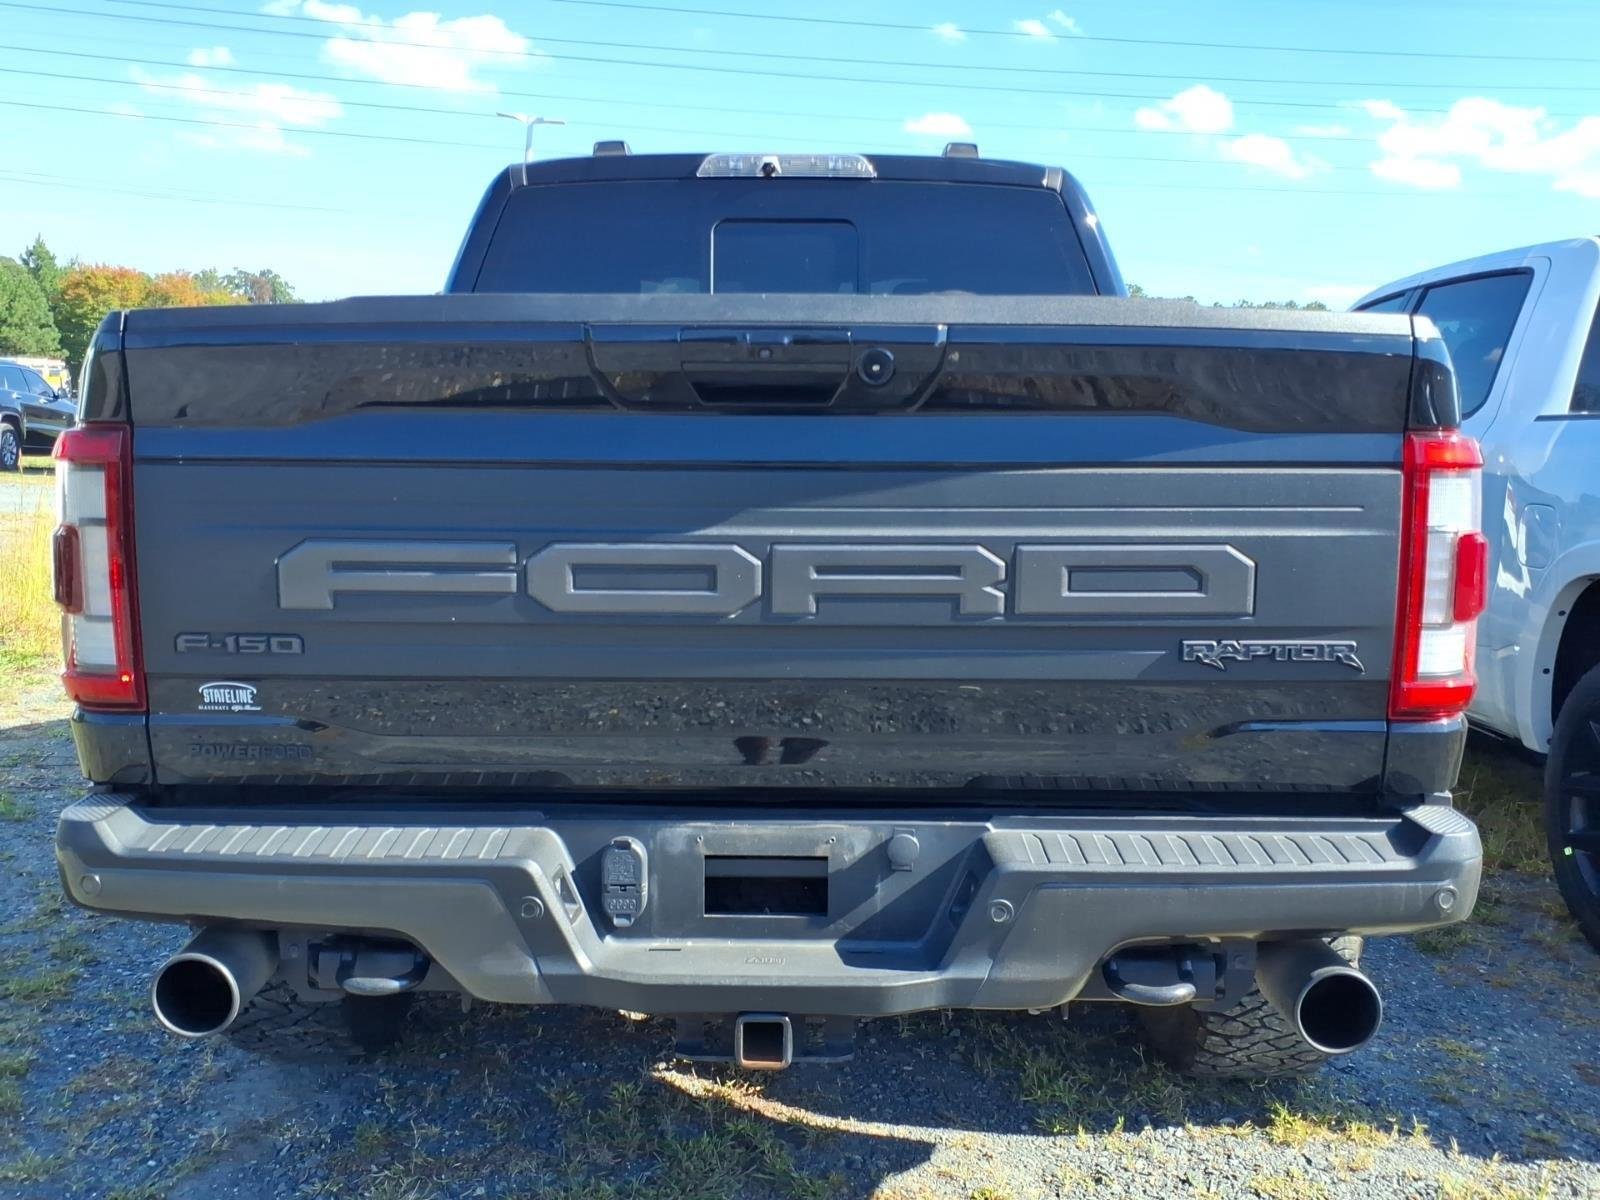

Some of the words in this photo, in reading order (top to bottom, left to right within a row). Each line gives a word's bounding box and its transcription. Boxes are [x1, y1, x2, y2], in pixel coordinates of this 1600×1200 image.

[276, 538, 1256, 617] FORD
[175, 633, 304, 653] F-150
[1180, 640, 1366, 673] RAPTOR
[203, 688, 254, 703] STATELINE
